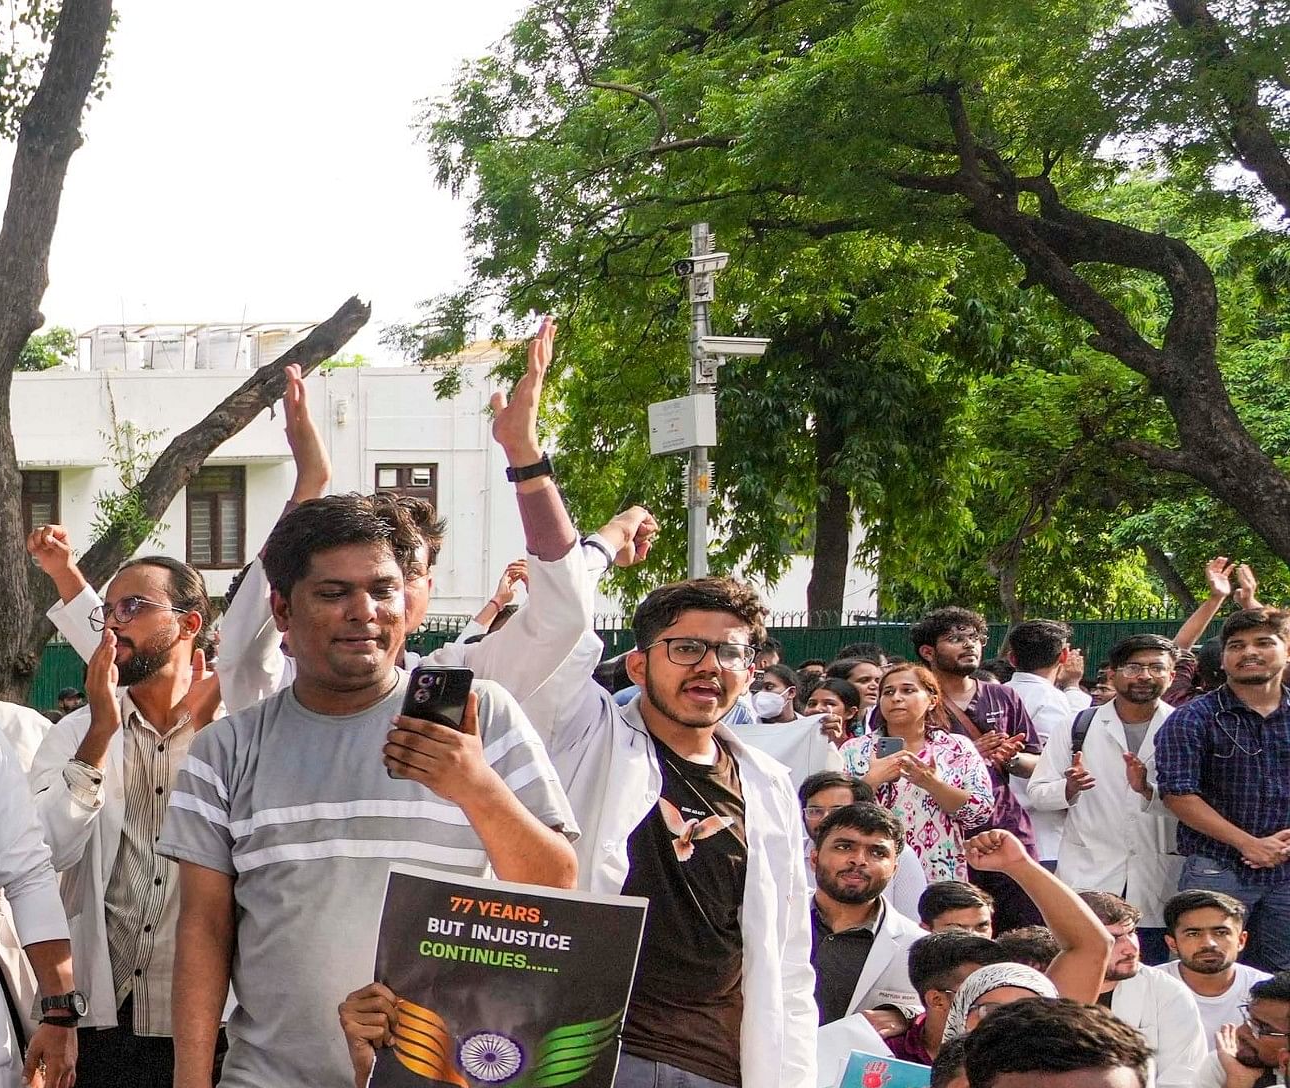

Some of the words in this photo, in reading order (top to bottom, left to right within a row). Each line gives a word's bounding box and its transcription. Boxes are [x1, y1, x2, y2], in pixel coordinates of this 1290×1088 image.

[451, 896, 474, 914] 77
[478, 899, 541, 924] YEARS
[427, 917, 465, 937] BUT
[471, 922, 571, 951] INJUSTICE
